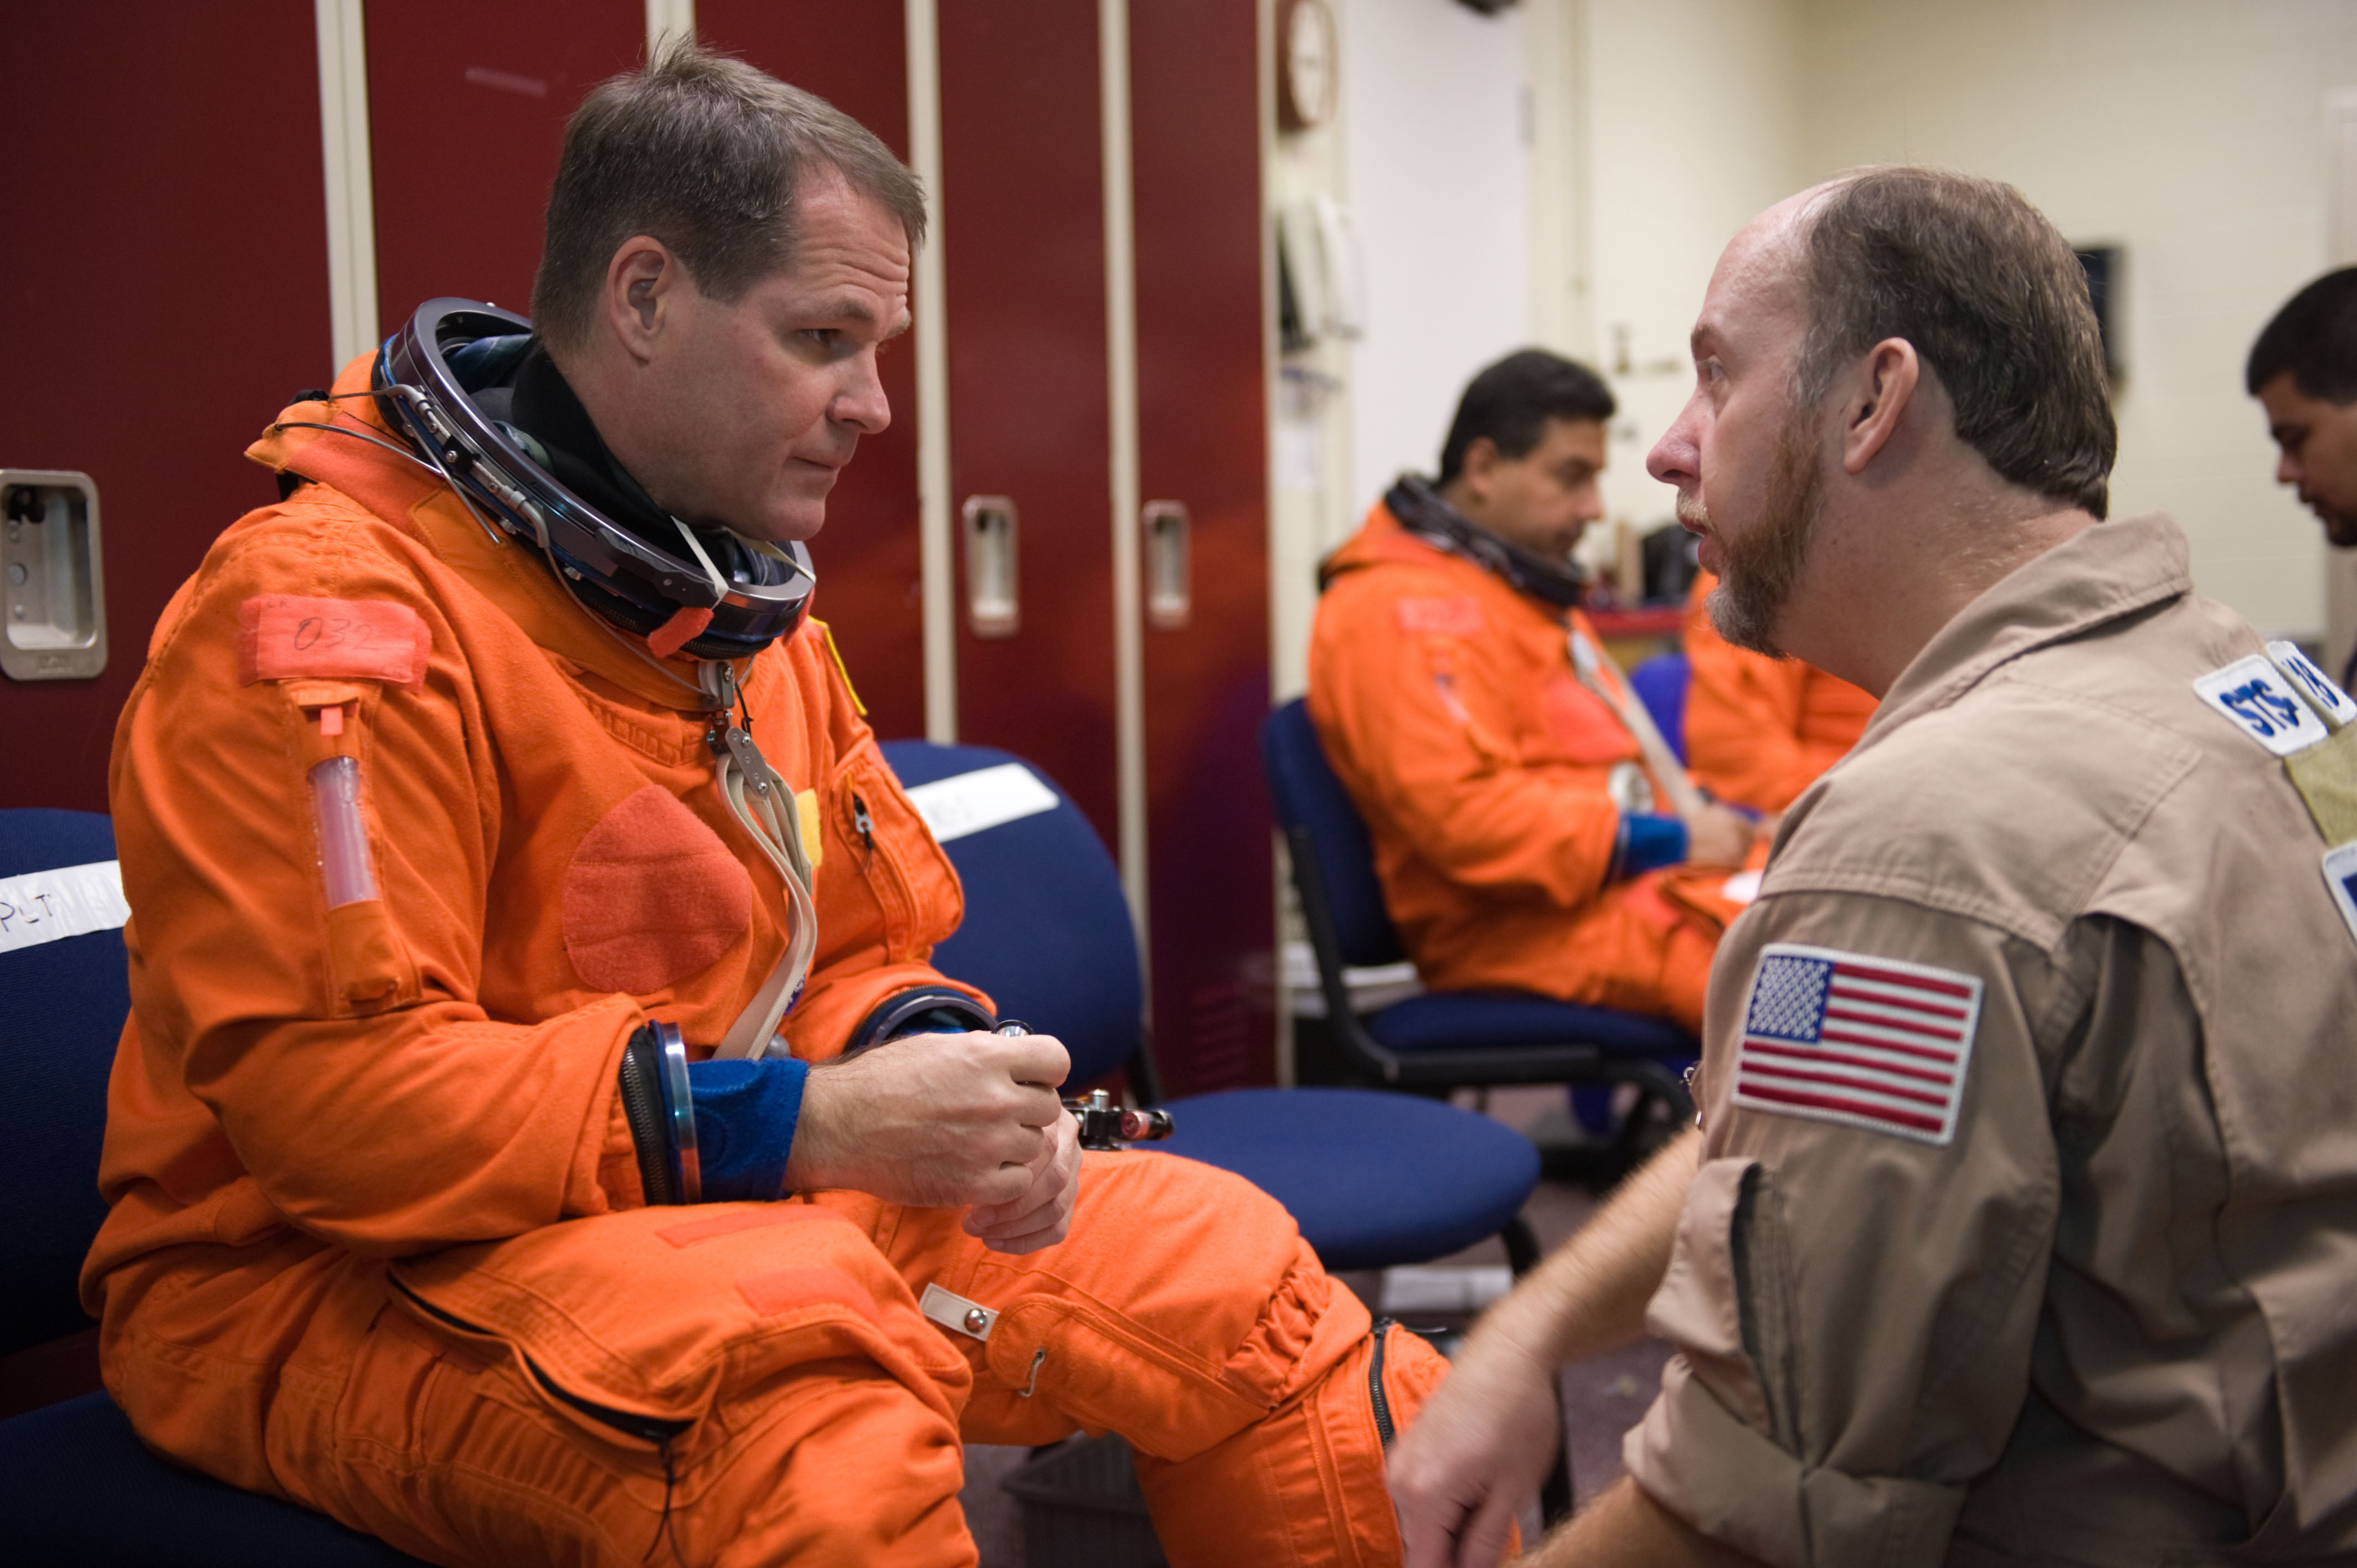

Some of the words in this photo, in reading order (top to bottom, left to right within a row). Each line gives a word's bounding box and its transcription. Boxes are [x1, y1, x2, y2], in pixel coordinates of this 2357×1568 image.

[294, 617, 380, 651] 032
[2219, 678, 2299, 737] STS
[0, 894, 53, 932] PLT
